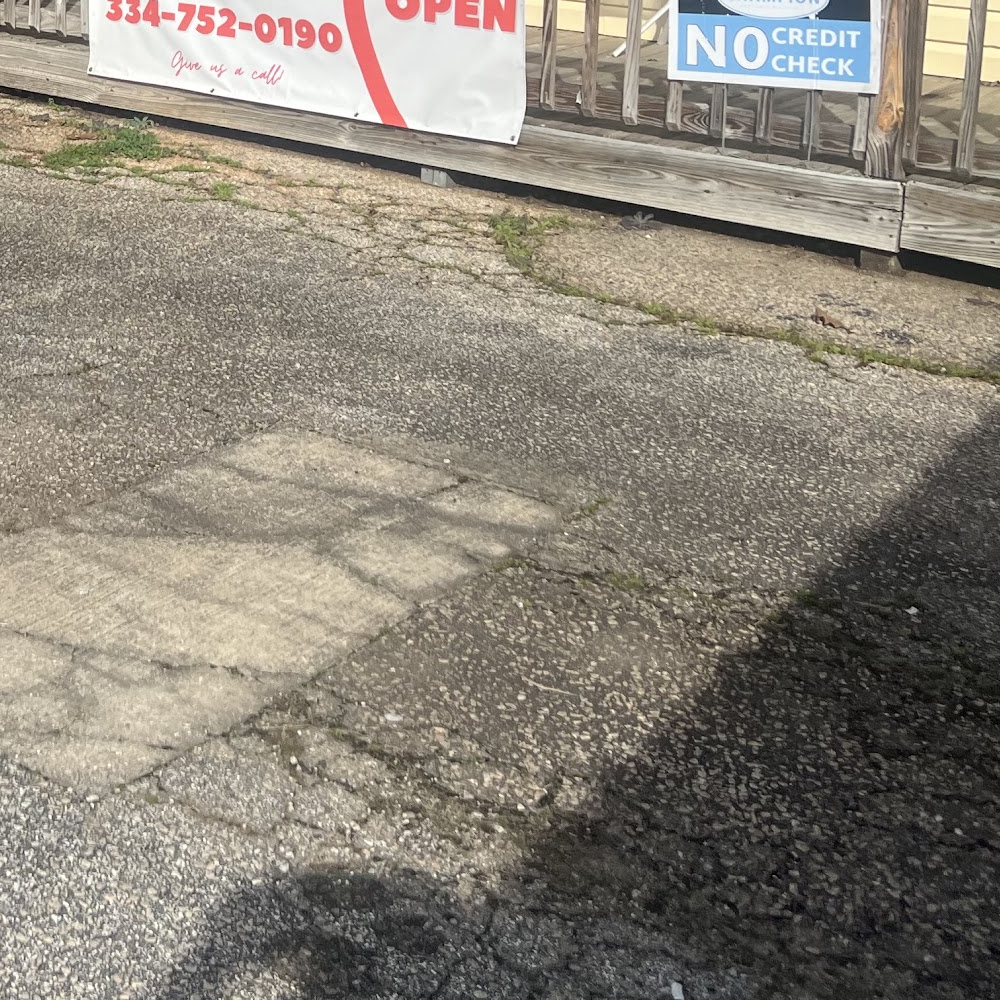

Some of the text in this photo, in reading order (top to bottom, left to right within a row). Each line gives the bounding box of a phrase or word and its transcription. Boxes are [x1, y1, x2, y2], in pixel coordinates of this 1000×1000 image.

[686, 24, 769, 70] NO
[771, 27, 861, 48] CREDIT
[171, 50, 202, 77] Give
[210, 63, 227, 78] us
[234, 66, 244, 76] a
[771, 55, 854, 76] CHECK
